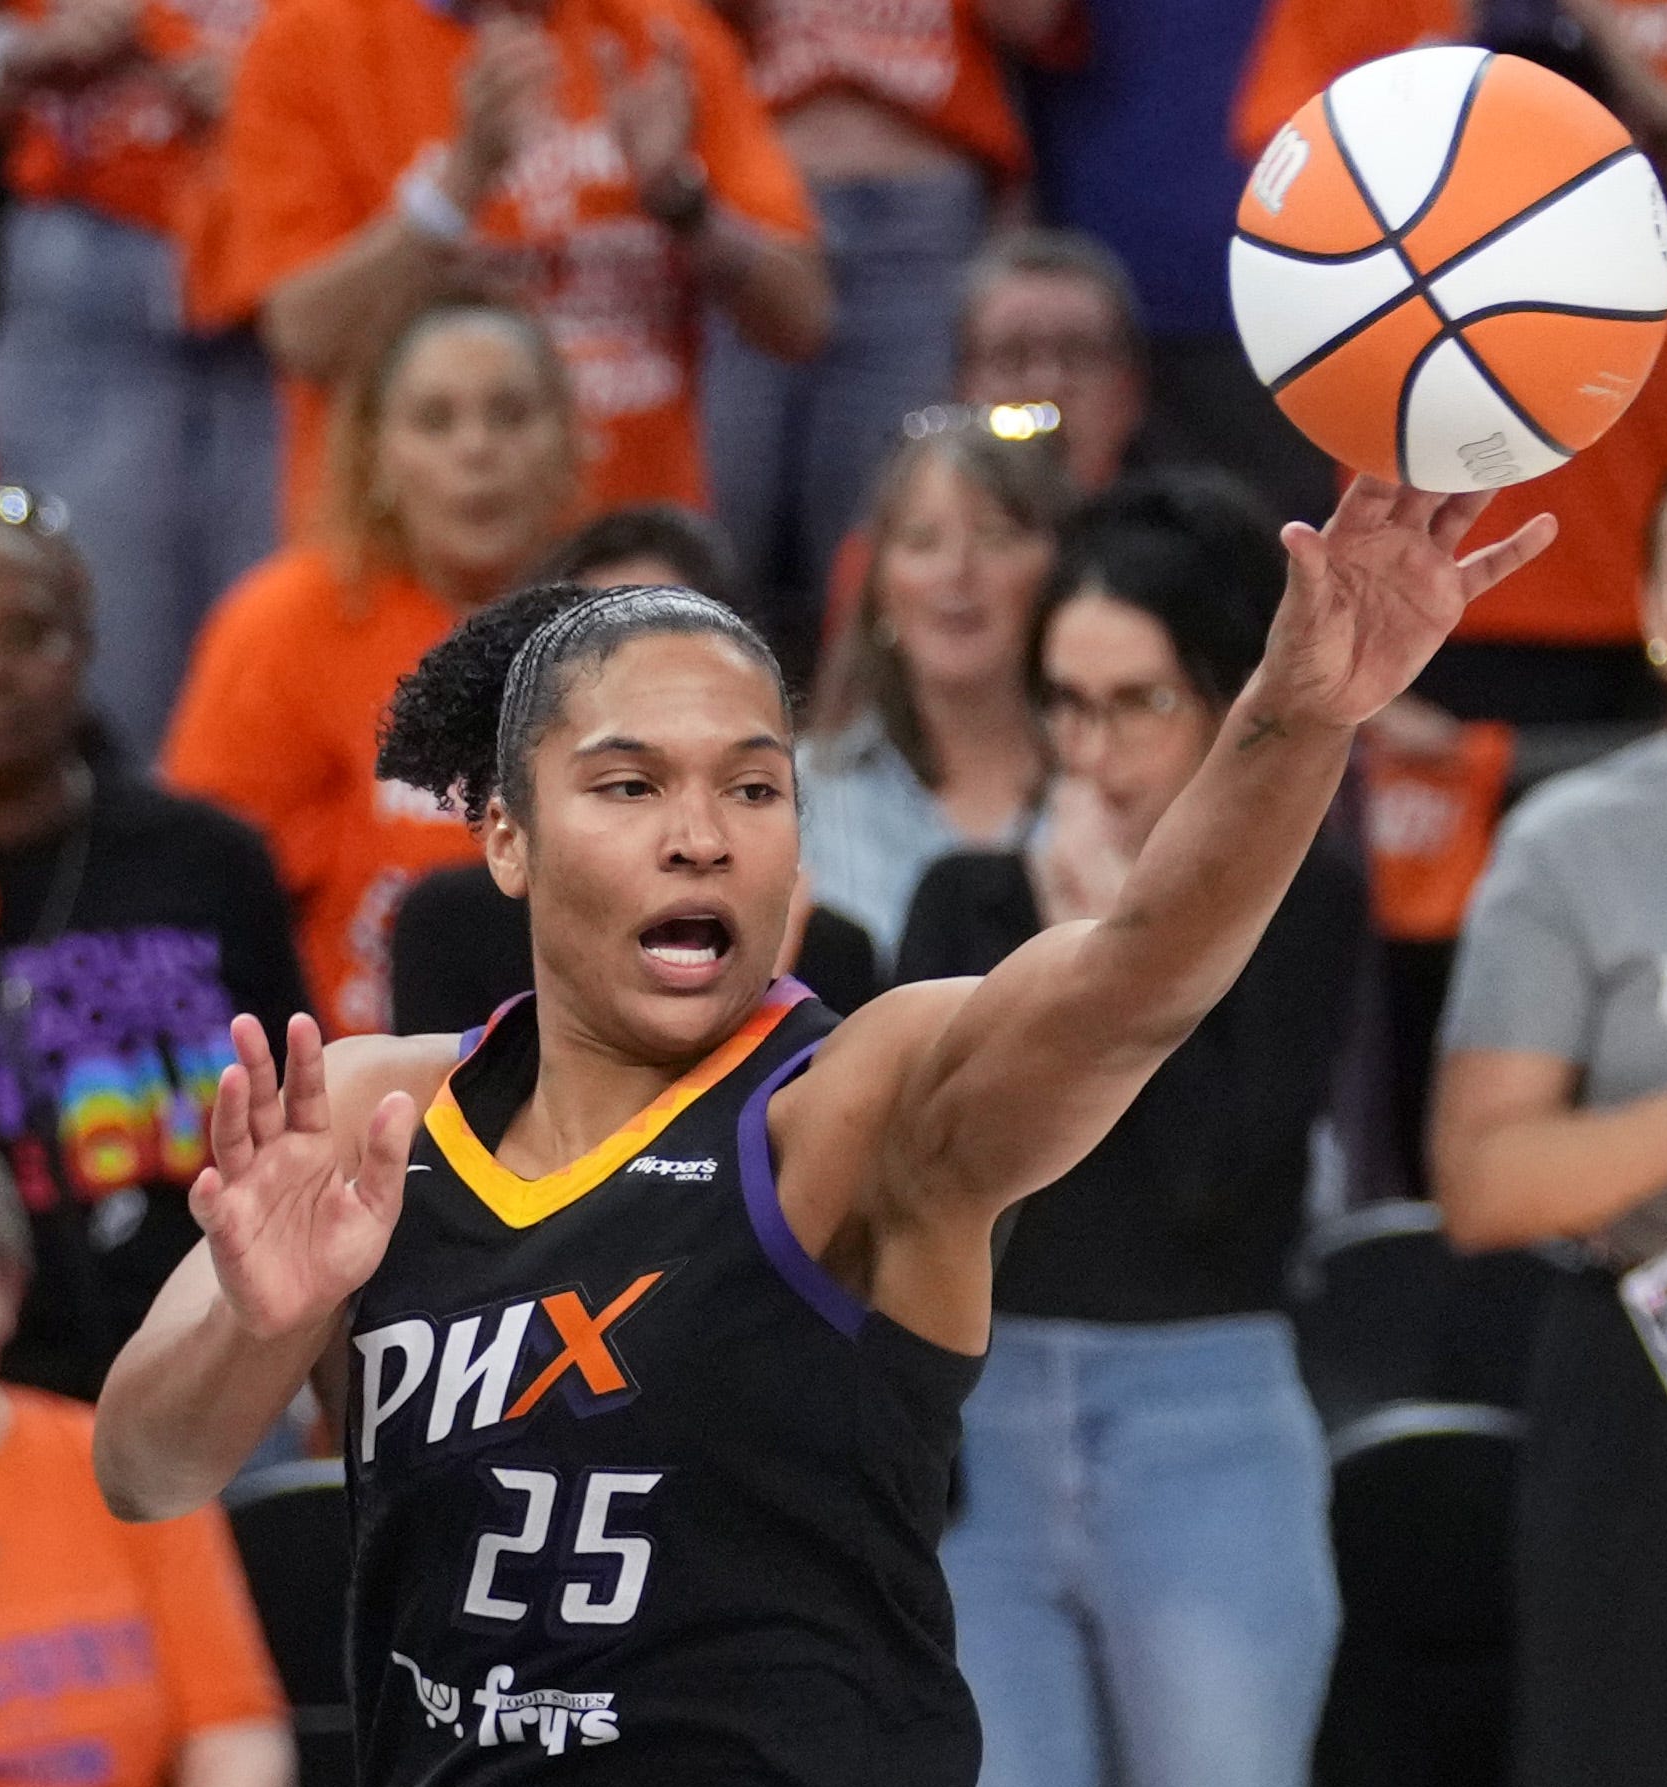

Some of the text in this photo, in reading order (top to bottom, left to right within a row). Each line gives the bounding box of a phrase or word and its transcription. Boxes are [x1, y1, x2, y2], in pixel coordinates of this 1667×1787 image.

[354, 1270, 664, 1463] PHX
[462, 1468, 665, 1624] 25
[497, 1691, 607, 1710] FOOD STORES
